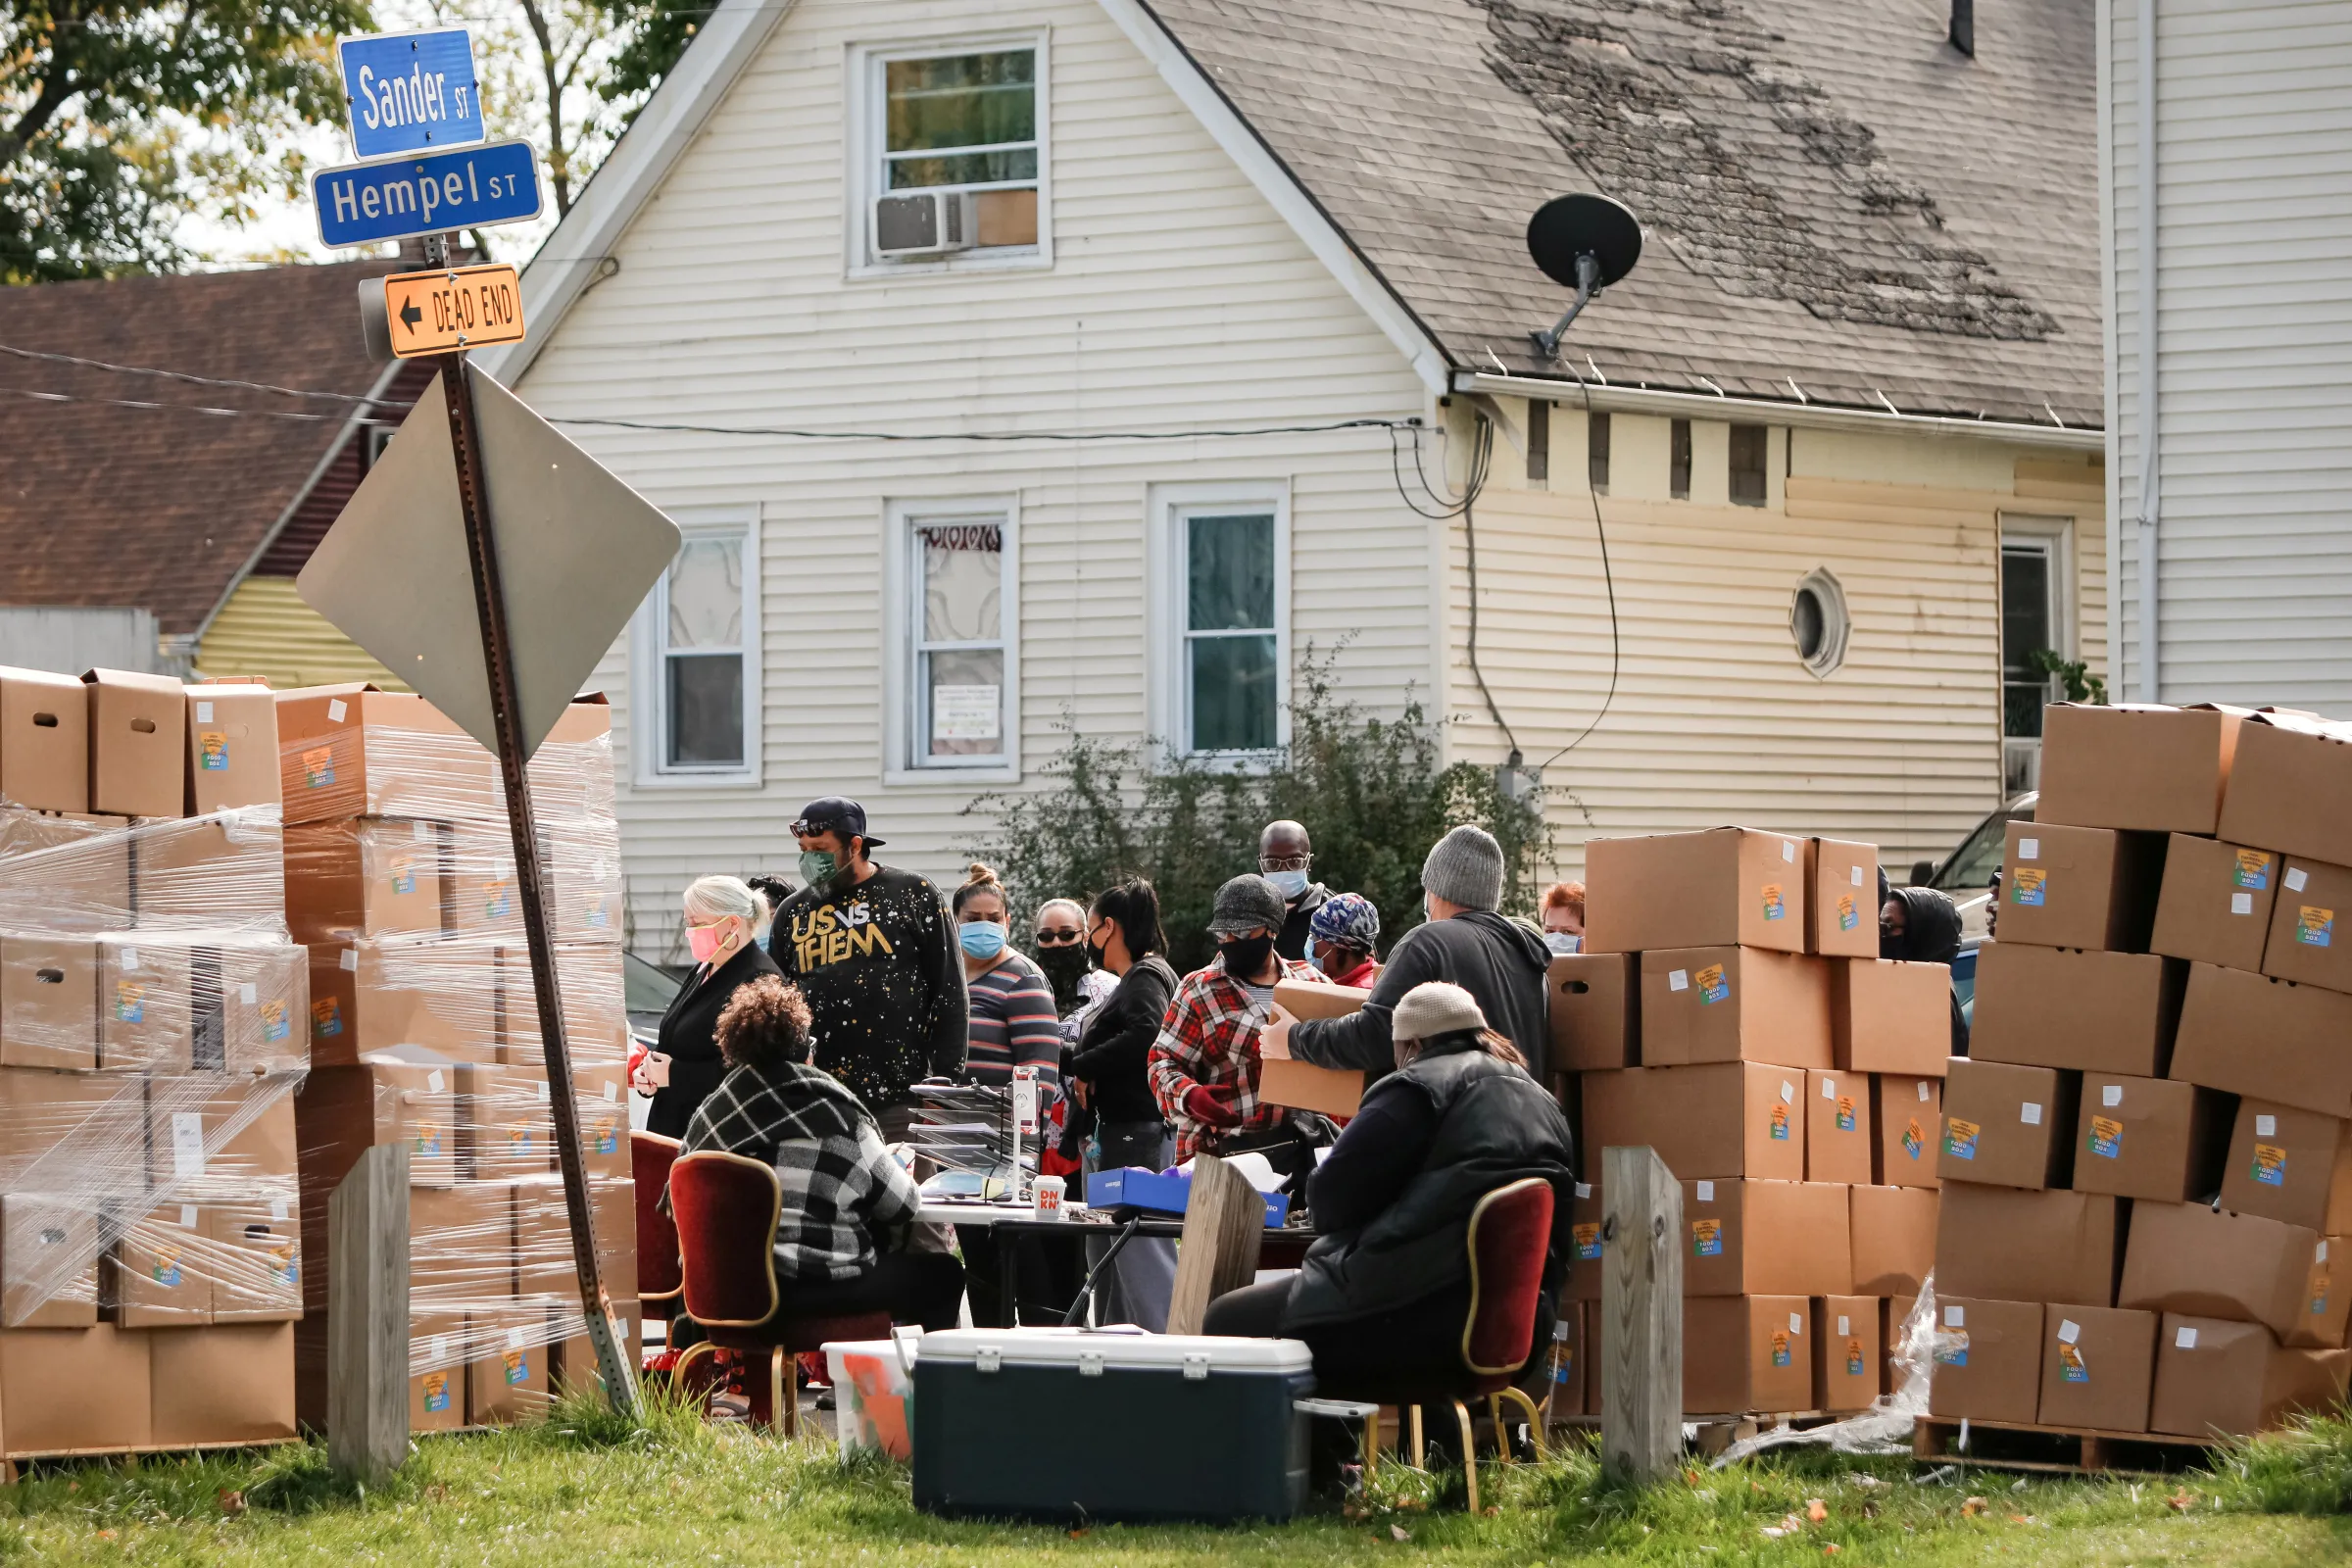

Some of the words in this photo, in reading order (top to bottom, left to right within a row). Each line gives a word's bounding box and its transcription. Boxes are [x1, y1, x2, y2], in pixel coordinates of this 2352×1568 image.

[359, 61, 446, 129] Sander
[455, 86, 469, 119] ST
[331, 161, 479, 223] Hempel
[490, 174, 515, 198] ST
[432, 288, 475, 333] DEAD
[480, 283, 513, 326] END
[792, 904, 837, 943] US
[834, 902, 870, 928] VS
[795, 922, 894, 970] THEM
[1705, 985, 1721, 995] FOOD
[1950, 1140, 1967, 1149] FOOD
[2094, 1138, 2112, 1148] FOOD
[2258, 1166, 2275, 1175] FOOD
[1040, 1190, 1058, 1200] DN
